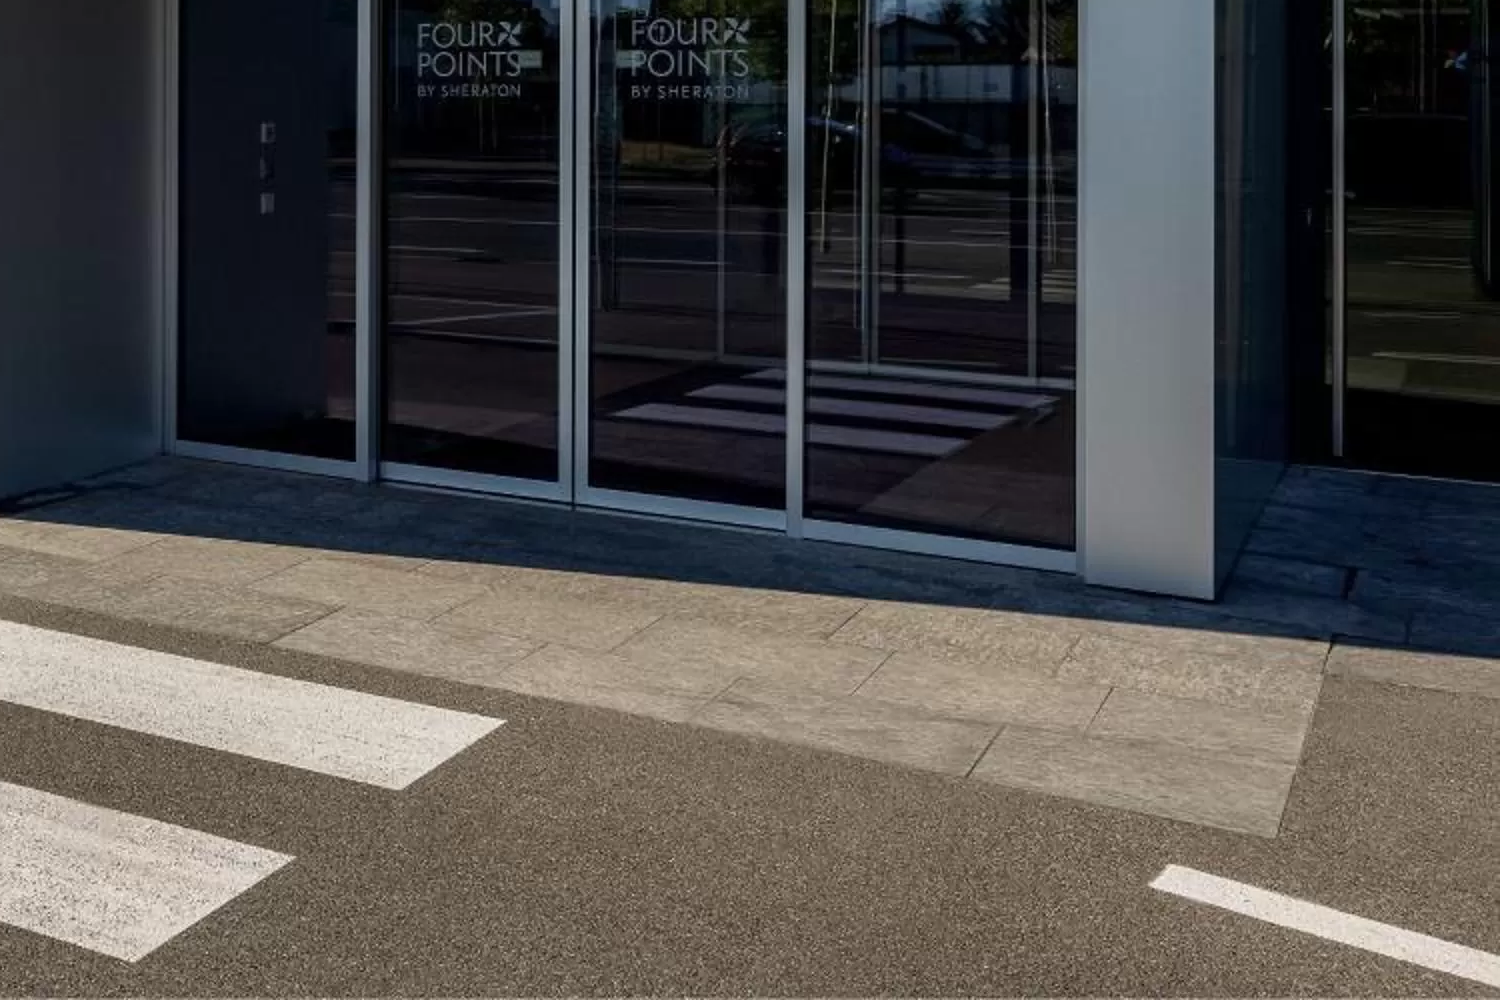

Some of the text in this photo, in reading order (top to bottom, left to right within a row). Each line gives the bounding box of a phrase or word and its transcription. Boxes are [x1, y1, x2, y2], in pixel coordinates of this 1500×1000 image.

[417, 21, 497, 49] FOUR
[632, 17, 720, 46] FOUR
[418, 51, 521, 77] POINTS
[632, 49, 748, 77] POINTS
[418, 83, 521, 98] BY SHERATON
[632, 84, 749, 98] BY SHERATON
